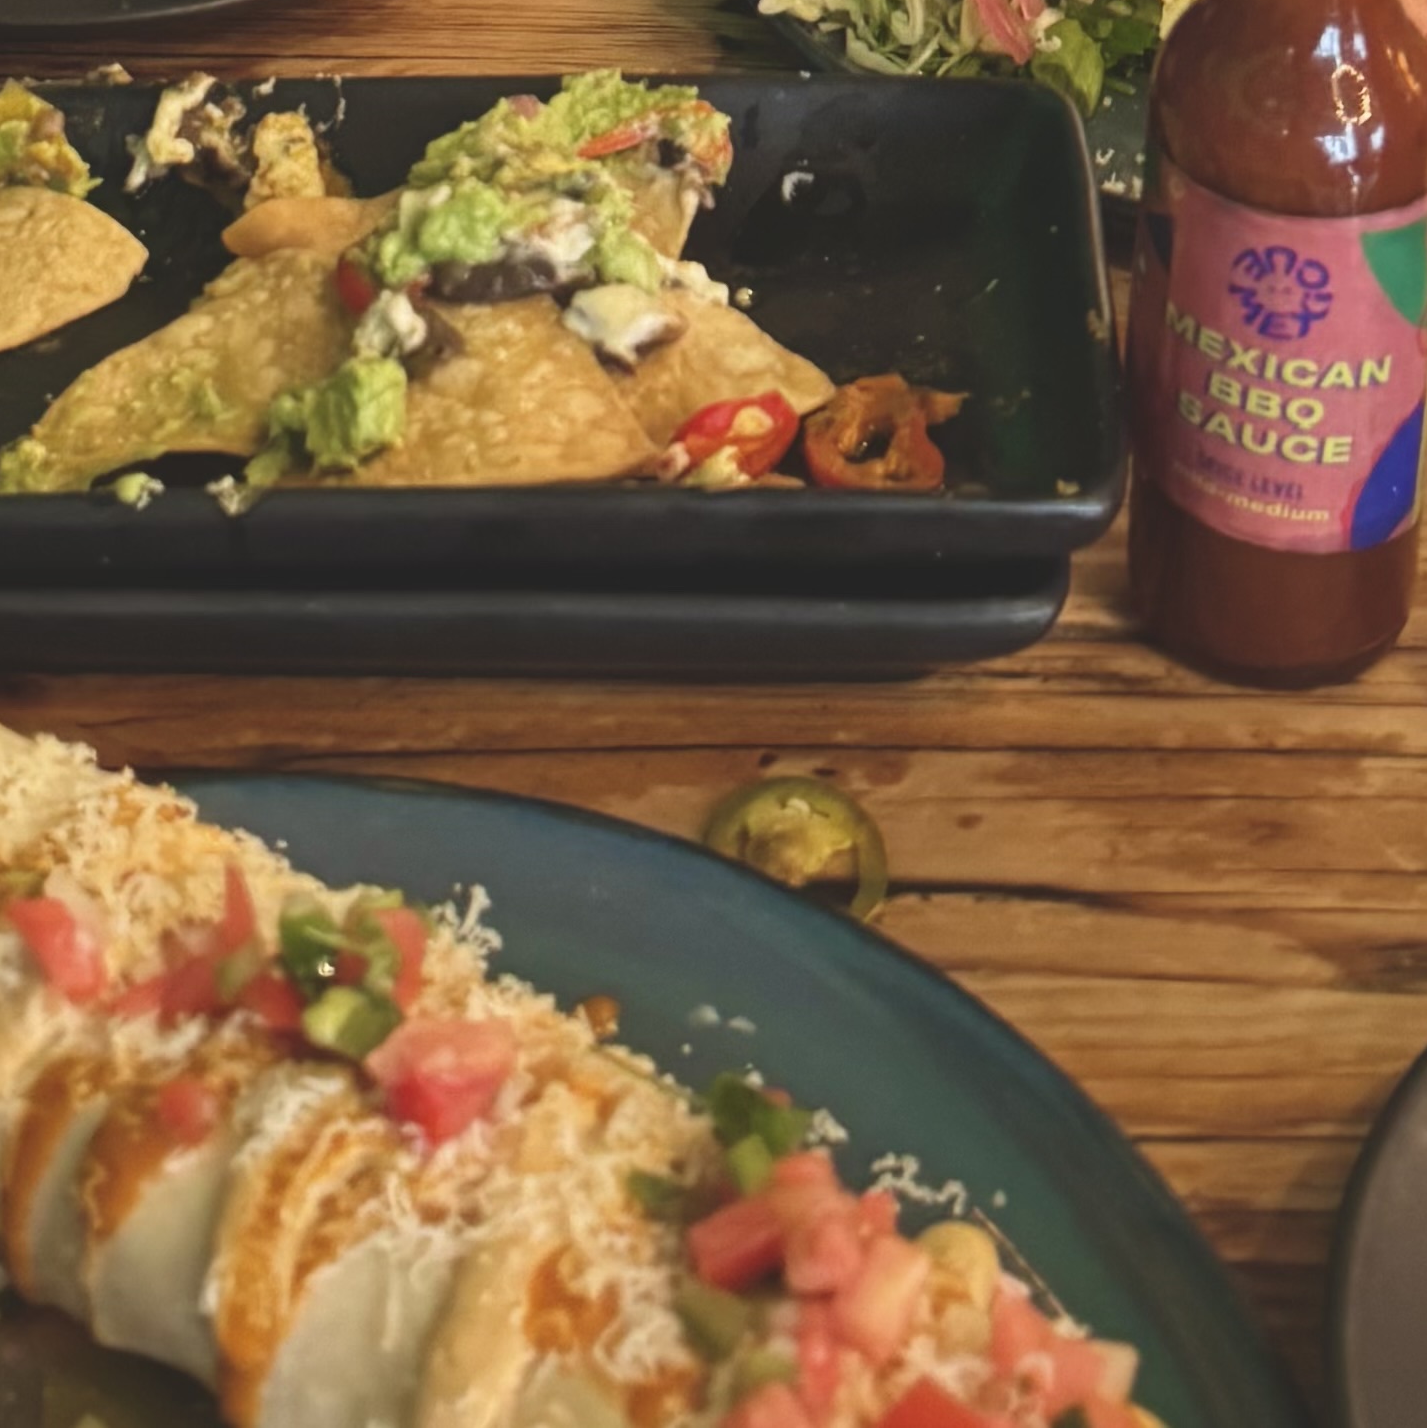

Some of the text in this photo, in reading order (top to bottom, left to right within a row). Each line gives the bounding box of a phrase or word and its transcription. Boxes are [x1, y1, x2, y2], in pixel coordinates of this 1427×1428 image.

[1166, 301, 1393, 390] MEXICAN
[1178, 392, 1352, 464] SAUCE
[1209, 371, 1324, 430] BBQ
